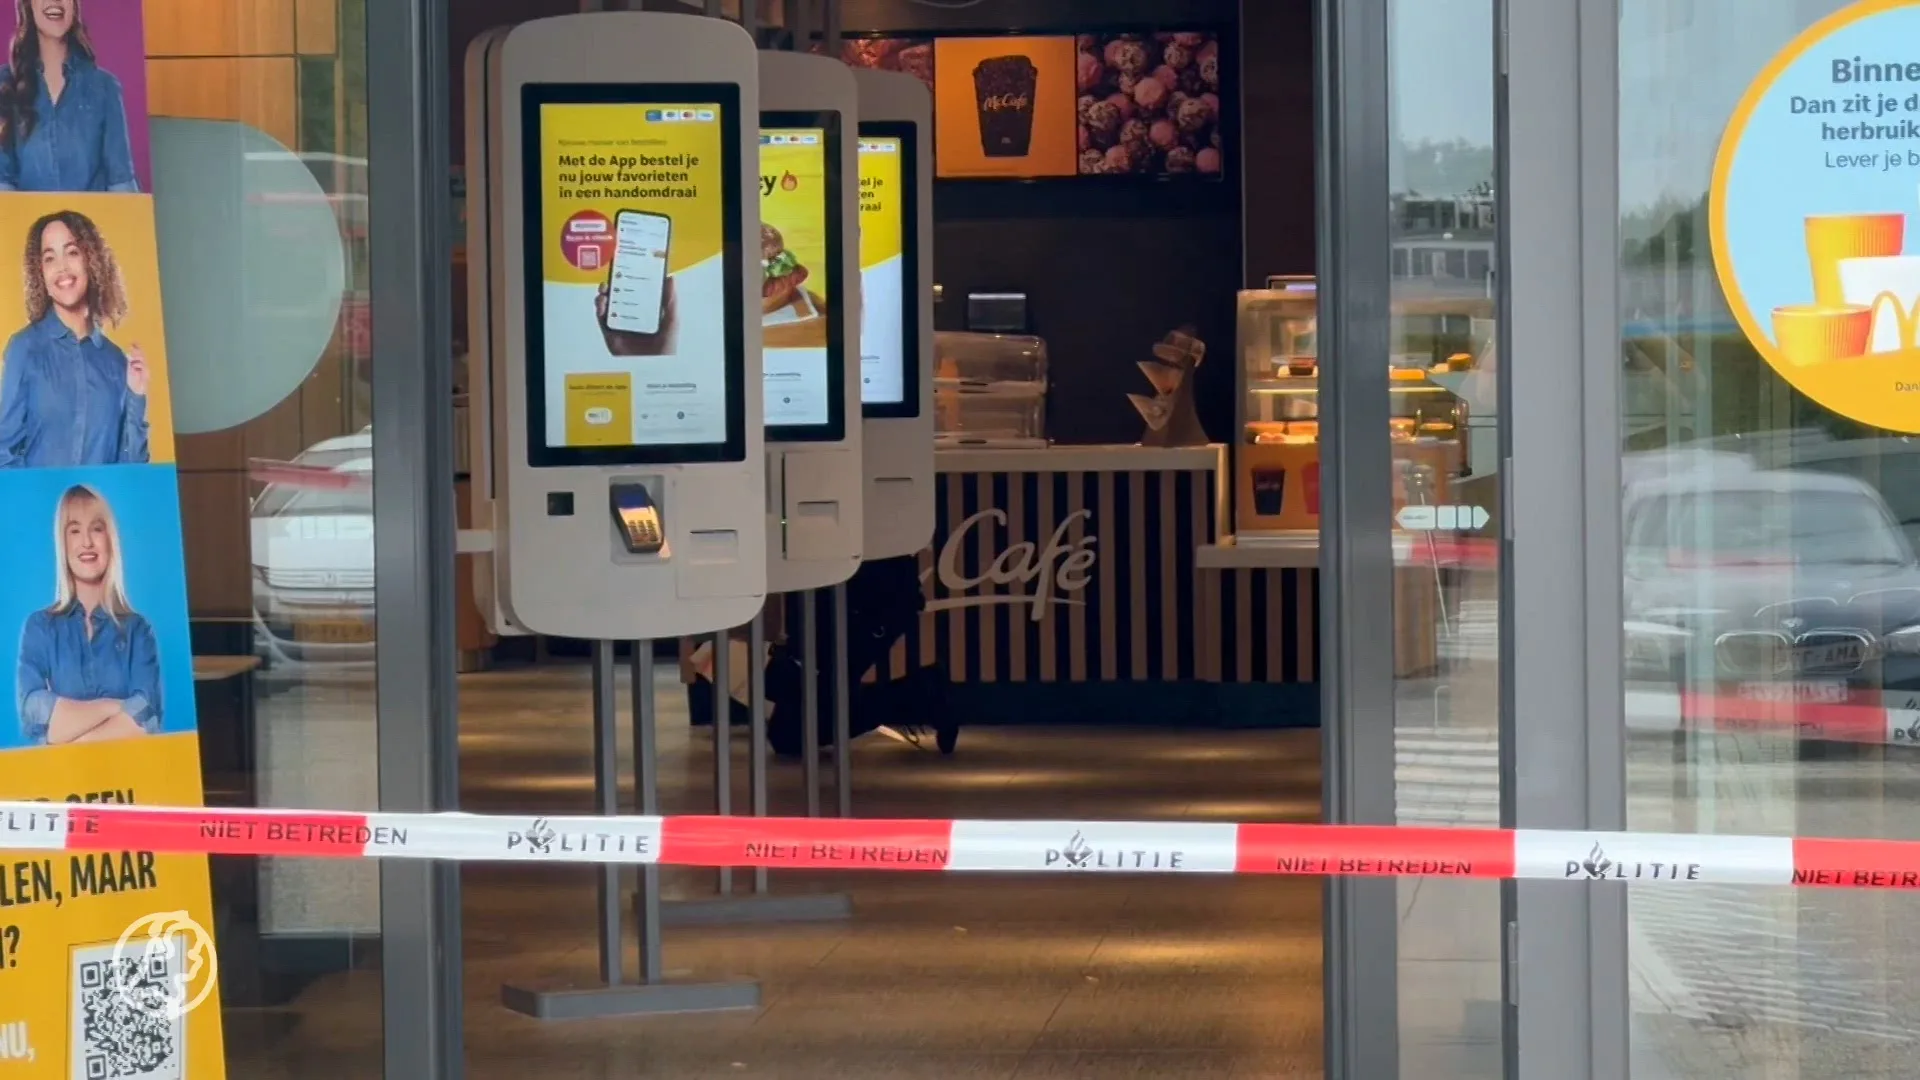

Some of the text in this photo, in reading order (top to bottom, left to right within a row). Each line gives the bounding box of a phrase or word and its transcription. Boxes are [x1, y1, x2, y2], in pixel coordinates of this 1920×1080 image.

[1832, 56, 1920, 84] Binne
[1790, 96, 1836, 113] Dan
[1842, 94, 1872, 113] zit
[1874, 92, 1898, 117] je
[1822, 120, 1920, 140] herbruik
[558, 154, 700, 169] Met de App bestel je
[1825, 152, 1879, 168] Lever
[1882, 150, 1902, 171] je
[558, 170, 689, 185] nu jouw favorieten
[759, 176, 777, 195] y
[859, 177, 884, 189] el je
[559, 186, 697, 198] in een handomdraai
[859, 190, 875, 199] en
[1895, 381, 1920, 392] Dan
[919, 508, 1097, 621] Café
[0, 811, 99, 834] LITIE
[200, 820, 408, 845] NIET BETREDEN
[746, 843, 948, 864] NIET BETREDEN
[70, 850, 157, 898] MAAR
[1276, 856, 1471, 874] NIET BETREDEN
[1792, 868, 1920, 886] NIET BETR
